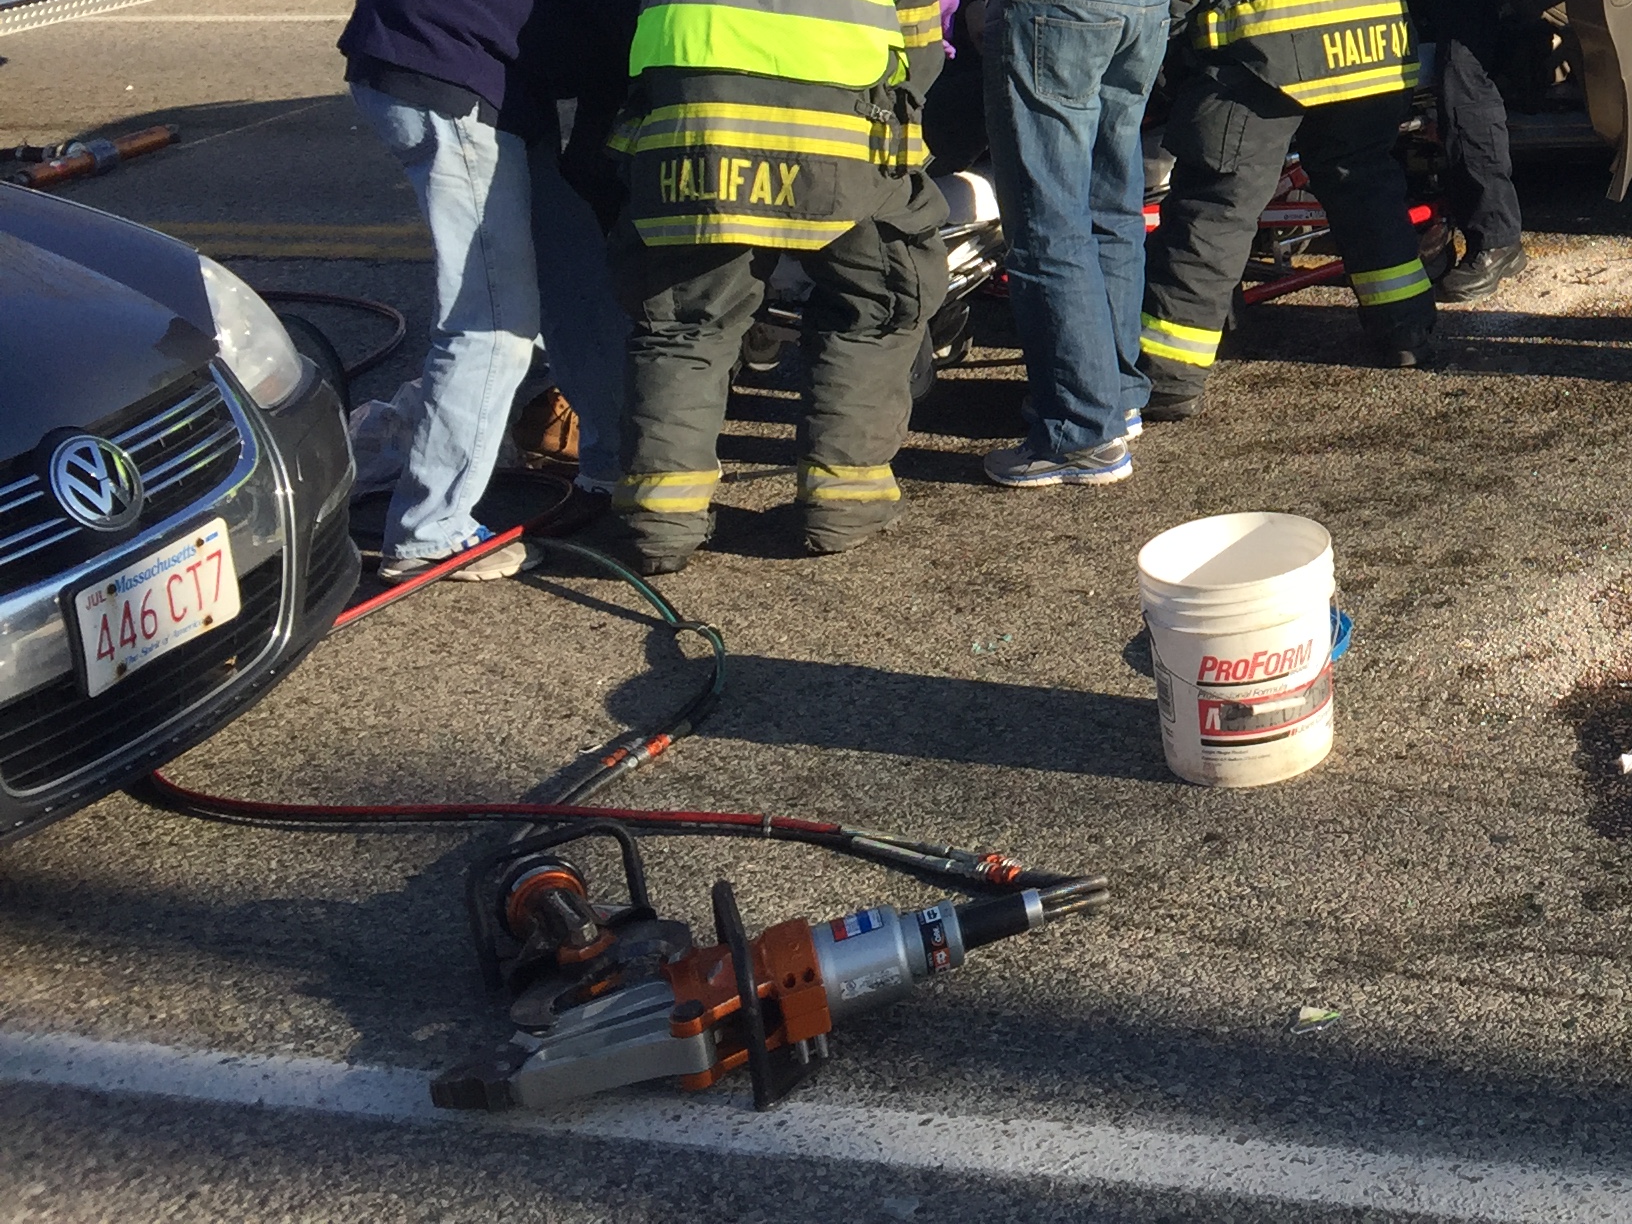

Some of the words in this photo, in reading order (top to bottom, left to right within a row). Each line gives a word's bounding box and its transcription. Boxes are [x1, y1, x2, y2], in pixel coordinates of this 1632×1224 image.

[1322, 20, 1411, 70] HALIFAX
[660, 156, 801, 208] HALIFAX
[114, 544, 197, 596] Massachusetts
[85, 590, 107, 611] JUL
[96, 588, 159, 661] 446
[165, 549, 222, 623] CT7
